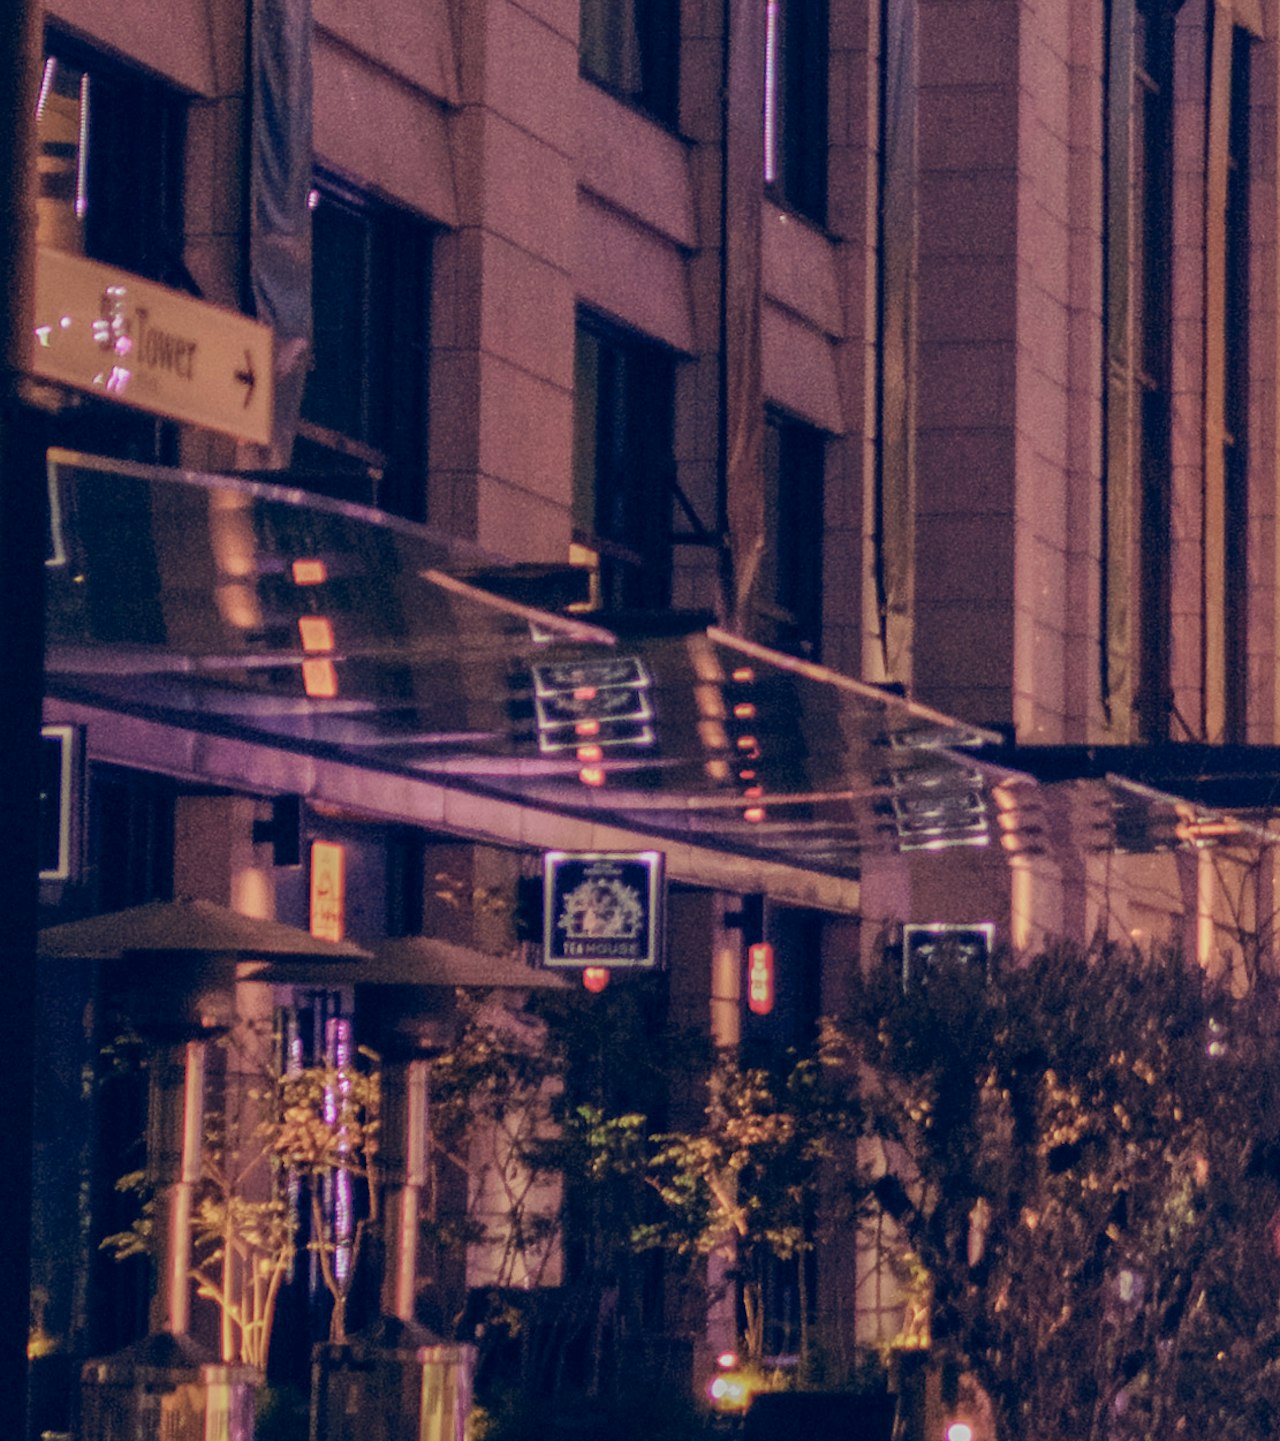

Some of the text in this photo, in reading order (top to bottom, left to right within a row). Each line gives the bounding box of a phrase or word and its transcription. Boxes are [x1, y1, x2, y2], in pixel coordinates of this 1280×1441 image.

[136, 307, 196, 381] Tower
[563, 942, 639, 956] TEA HOUSE
